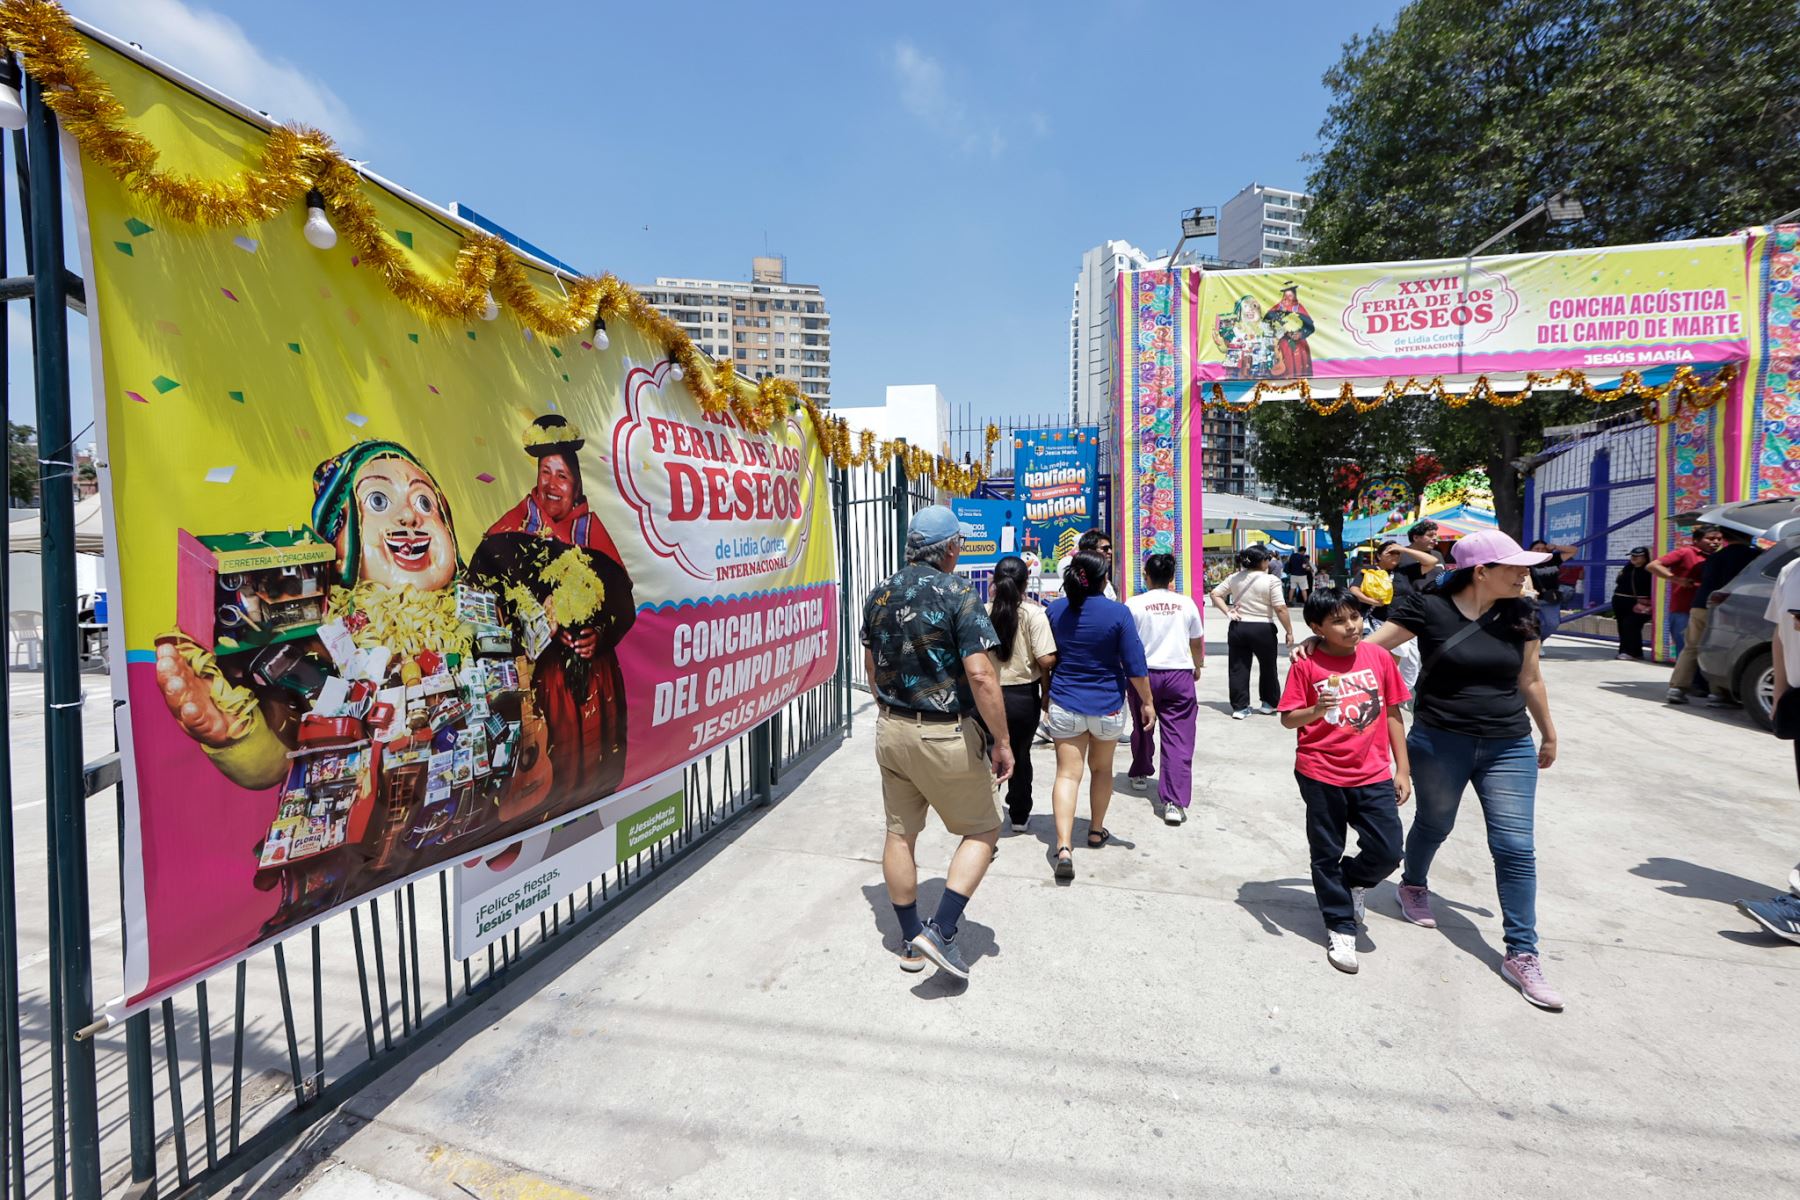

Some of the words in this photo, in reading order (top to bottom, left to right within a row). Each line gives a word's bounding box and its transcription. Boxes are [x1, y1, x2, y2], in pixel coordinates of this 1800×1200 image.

[1398, 276, 1460, 295] XXVII
[1361, 297, 1418, 314] FERIA
[1425, 293, 1451, 308] DE
[1457, 289, 1494, 304] LOS
[1549, 295, 1626, 319] CONCHA
[1630, 289, 1726, 315] ACÚSTICA
[1366, 303, 1494, 334] DESEOS
[1537, 325, 1568, 344] DEL
[1573, 319, 1640, 342] CAMPO
[1644, 318, 1667, 338] DE
[1672, 313, 1740, 337] MARTE
[1394, 336, 1406, 345] de
[1408, 334, 1431, 344] Lidia
[1432, 332, 1464, 342] Cortez
[1395, 341, 1466, 353] INTERNACIONAL
[1584, 351, 1635, 365] JESÚS
[1638, 347, 1694, 362] MARÍA
[647, 416, 738, 464] FERIA
[738, 438, 770, 468] DE
[771, 443, 800, 473] LOS
[1025, 467, 1086, 488] navidad
[1049, 460, 1069, 470] mejor
[664, 462, 803, 521] DESEOS
[1026, 495, 1086, 521] unidad
[715, 538, 731, 560] de
[734, 537, 758, 557] Lidia
[960, 544, 995, 552] NCLUSIVOS
[223, 557, 272, 569] FERRETERIA
[716, 557, 788, 582] INTERNACIONAL
[673, 611, 762, 668] CONCHA
[765, 598, 823, 643] ACÚSTICA
[652, 673, 700, 728] DEL
[705, 650, 772, 707] CAMPO
[774, 643, 792, 679] DE
[688, 700, 756, 751] JESÚS
[756, 674, 800, 717] MARÍA
[629, 805, 675, 837] #JesúsMaría
[294, 834, 321, 849] GLORIA
[476, 889, 521, 924] ¡Felices
[523, 866, 561, 895] fiestas,
[476, 910, 512, 938] Jesús
[514, 884, 551, 916] María!
